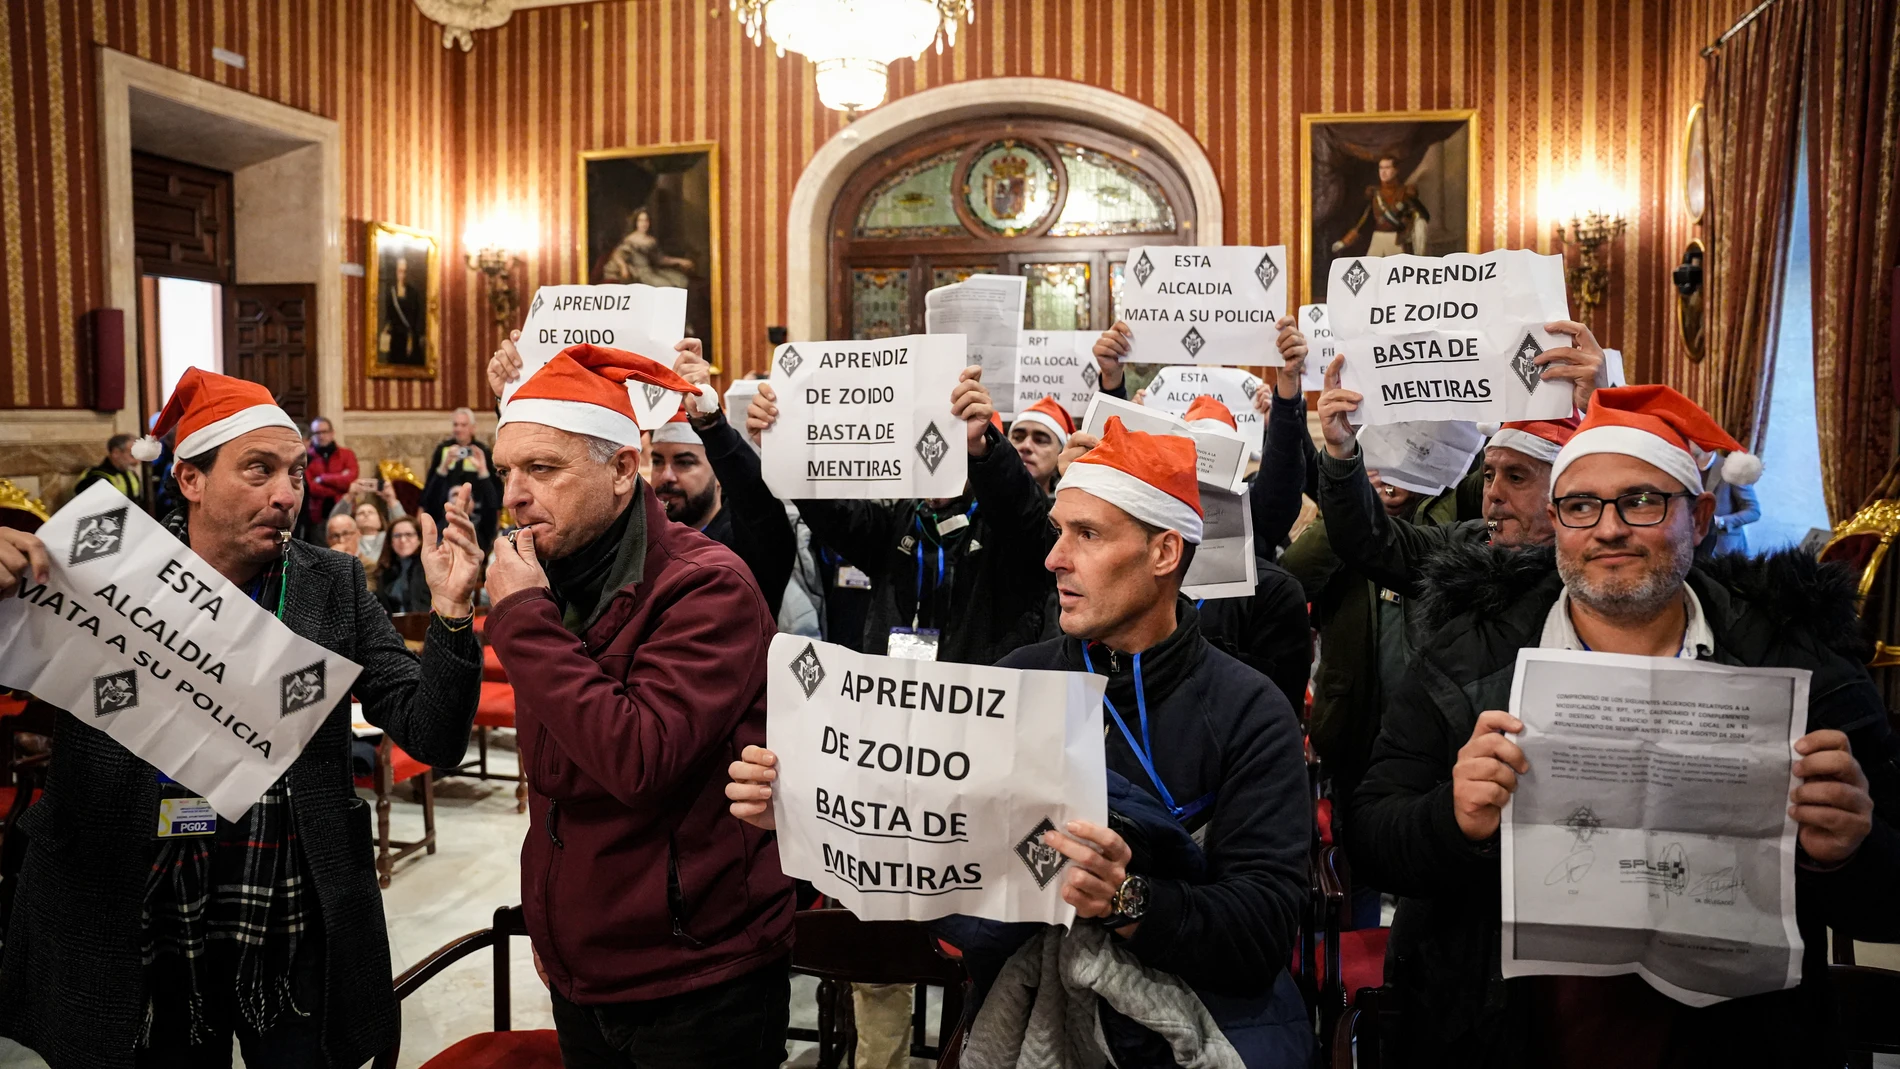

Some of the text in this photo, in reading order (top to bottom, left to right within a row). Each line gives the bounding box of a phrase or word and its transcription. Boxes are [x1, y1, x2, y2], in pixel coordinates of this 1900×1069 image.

[1174, 254, 1212, 268] ESTA
[1386, 261, 1497, 286] APRENDIZ
[1157, 281, 1233, 295] ALCALDIA
[553, 295, 632, 311] APRENDIZ
[1124, 308, 1276, 323] MATA A SU POLICIA
[1369, 301, 1479, 325] DE ZOIDO
[539, 329, 615, 345] DE ZOIDO
[1028, 336, 1049, 346] RPT
[819, 348, 909, 369] APRENDIZ
[1373, 337, 1478, 365] BASTA DE
[1044, 356, 1079, 366] LOCAL
[1043, 375, 1065, 385] QUE
[1180, 373, 1209, 383] ESTA
[806, 386, 894, 405] DE ZOIDO
[1381, 378, 1491, 402] MENTIRAS
[807, 423, 895, 441] BASTA DE
[807, 459, 902, 478] MENTIRAS
[156, 558, 225, 622] ESTA
[93, 583, 228, 685] ALCALDIA
[17, 576, 273, 759] MATA A SU POLICIA
[840, 670, 1007, 719] APRENDIZ
[1556, 693, 1599, 701] COMPROMISO
[1698, 703, 1733, 711] RELATIVOS
[1619, 716, 1649, 724] SERVICIO
[1698, 712, 1750, 720] COMPLEMENTO
[821, 725, 971, 781] DE ZOIDO
[816, 787, 967, 837] BASTA DE
[180, 822, 208, 832] PG02
[822, 843, 983, 890] MENTIRAS
[1618, 859, 1670, 872] SPLS
